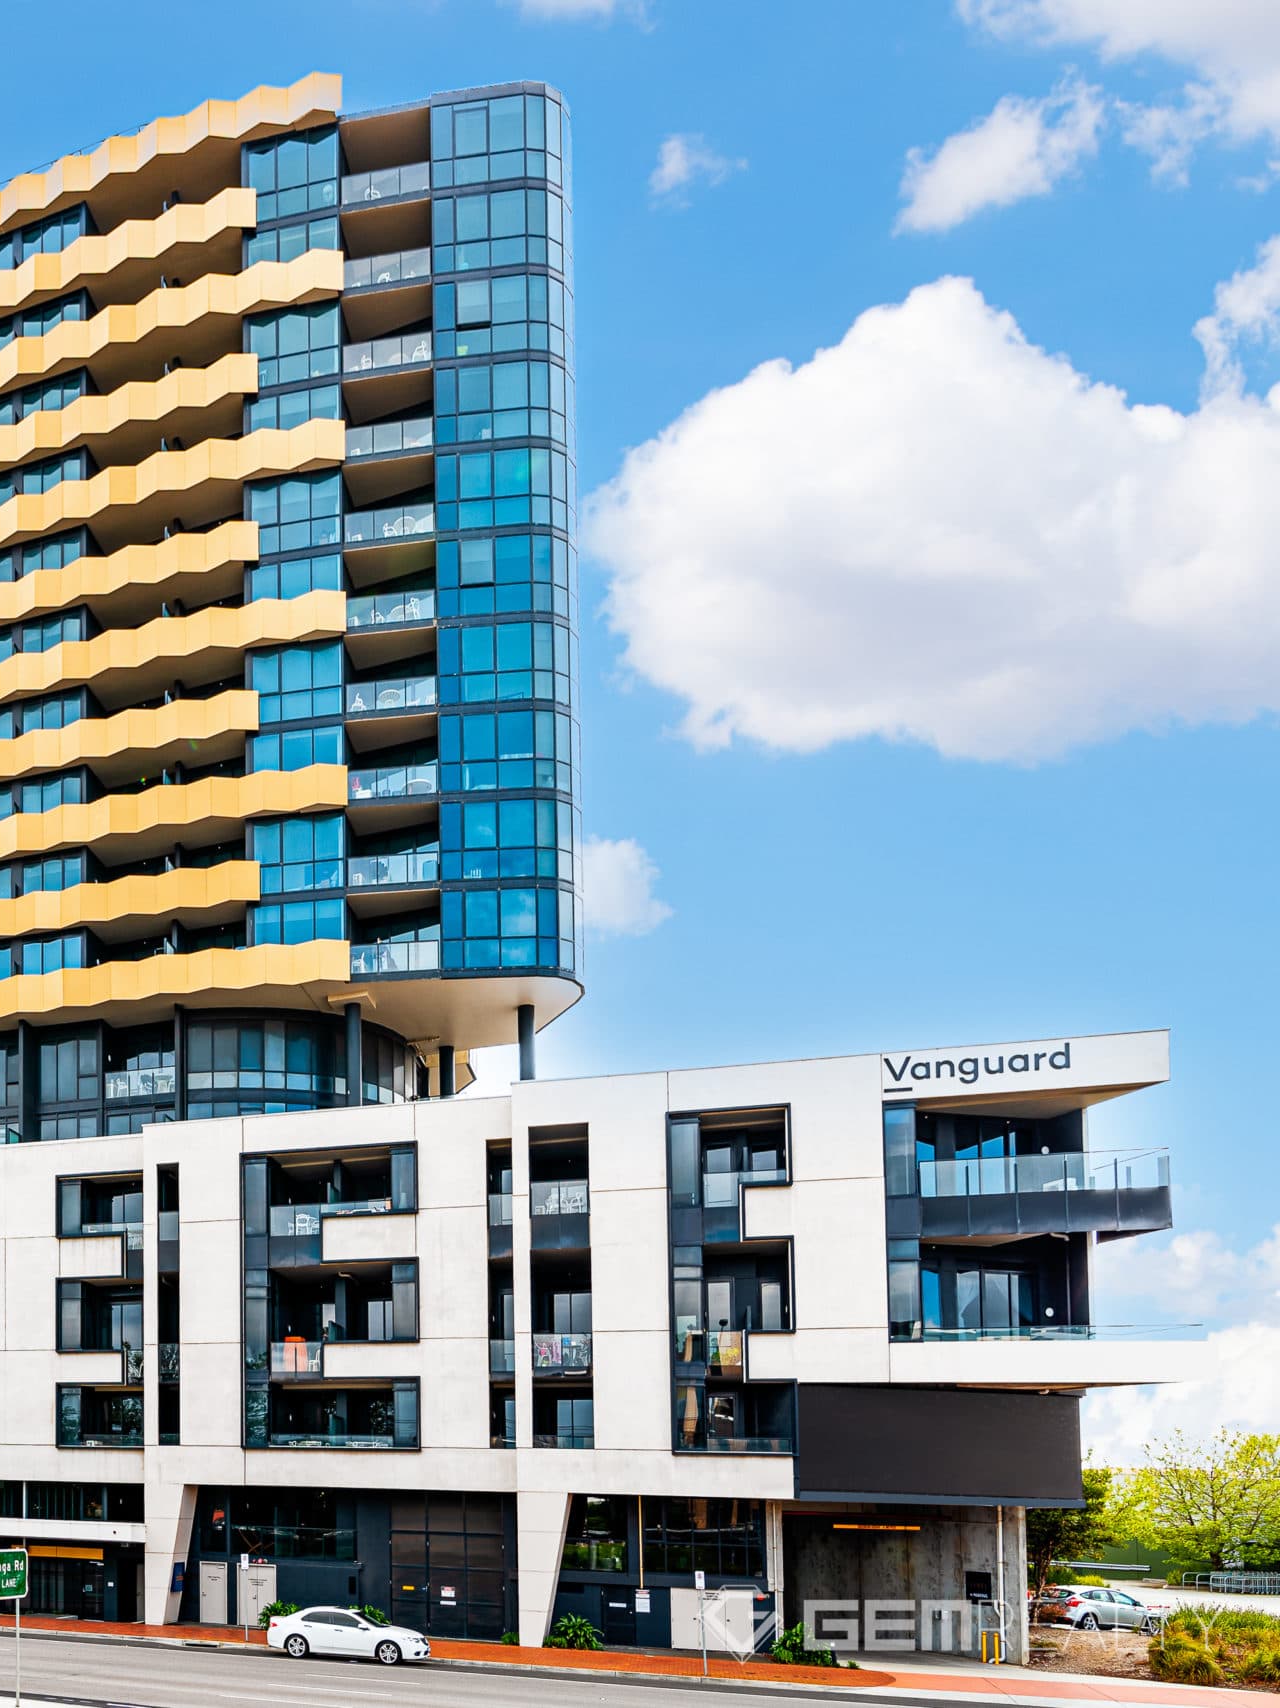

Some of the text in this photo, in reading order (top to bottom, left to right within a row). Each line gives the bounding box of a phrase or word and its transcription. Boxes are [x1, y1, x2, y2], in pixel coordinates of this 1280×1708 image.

[883, 1042, 1070, 1093] Vanguard
[14, 1560, 24, 1571] Rd
[1, 1578, 16, 1588] LANE
